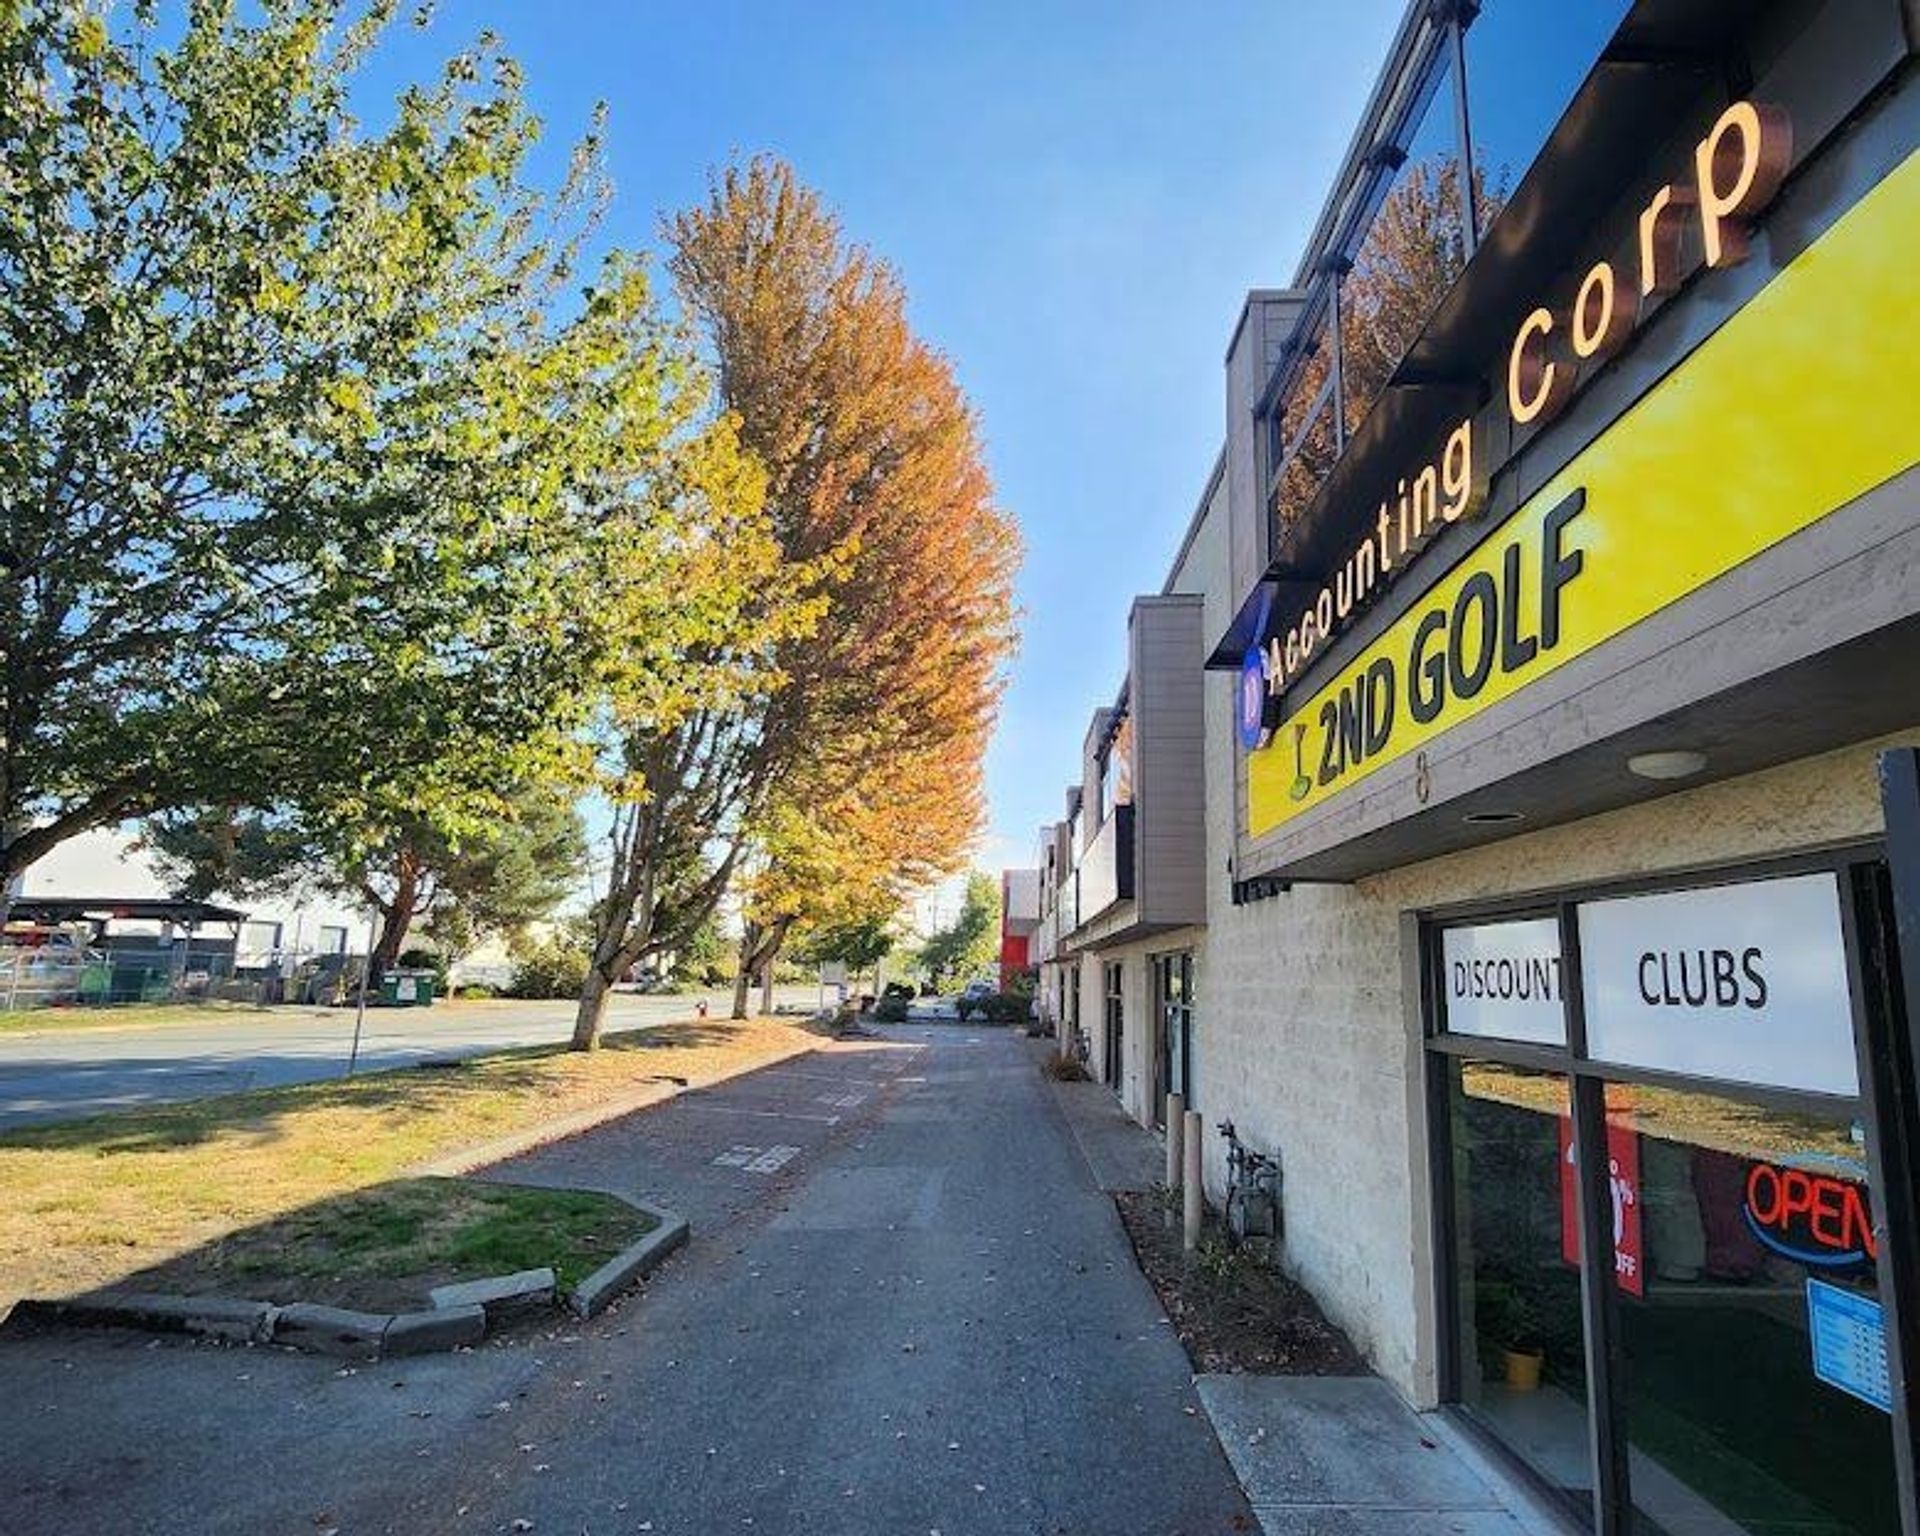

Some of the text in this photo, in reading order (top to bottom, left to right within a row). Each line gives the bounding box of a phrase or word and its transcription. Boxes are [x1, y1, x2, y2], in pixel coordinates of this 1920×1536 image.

[1268, 101, 1761, 696] Accounting Corp
[1318, 487, 1587, 786] 2ND GOLF
[1416, 750, 1430, 804] 8
[1454, 947, 1768, 1010] DISCOUNT CLUBS
